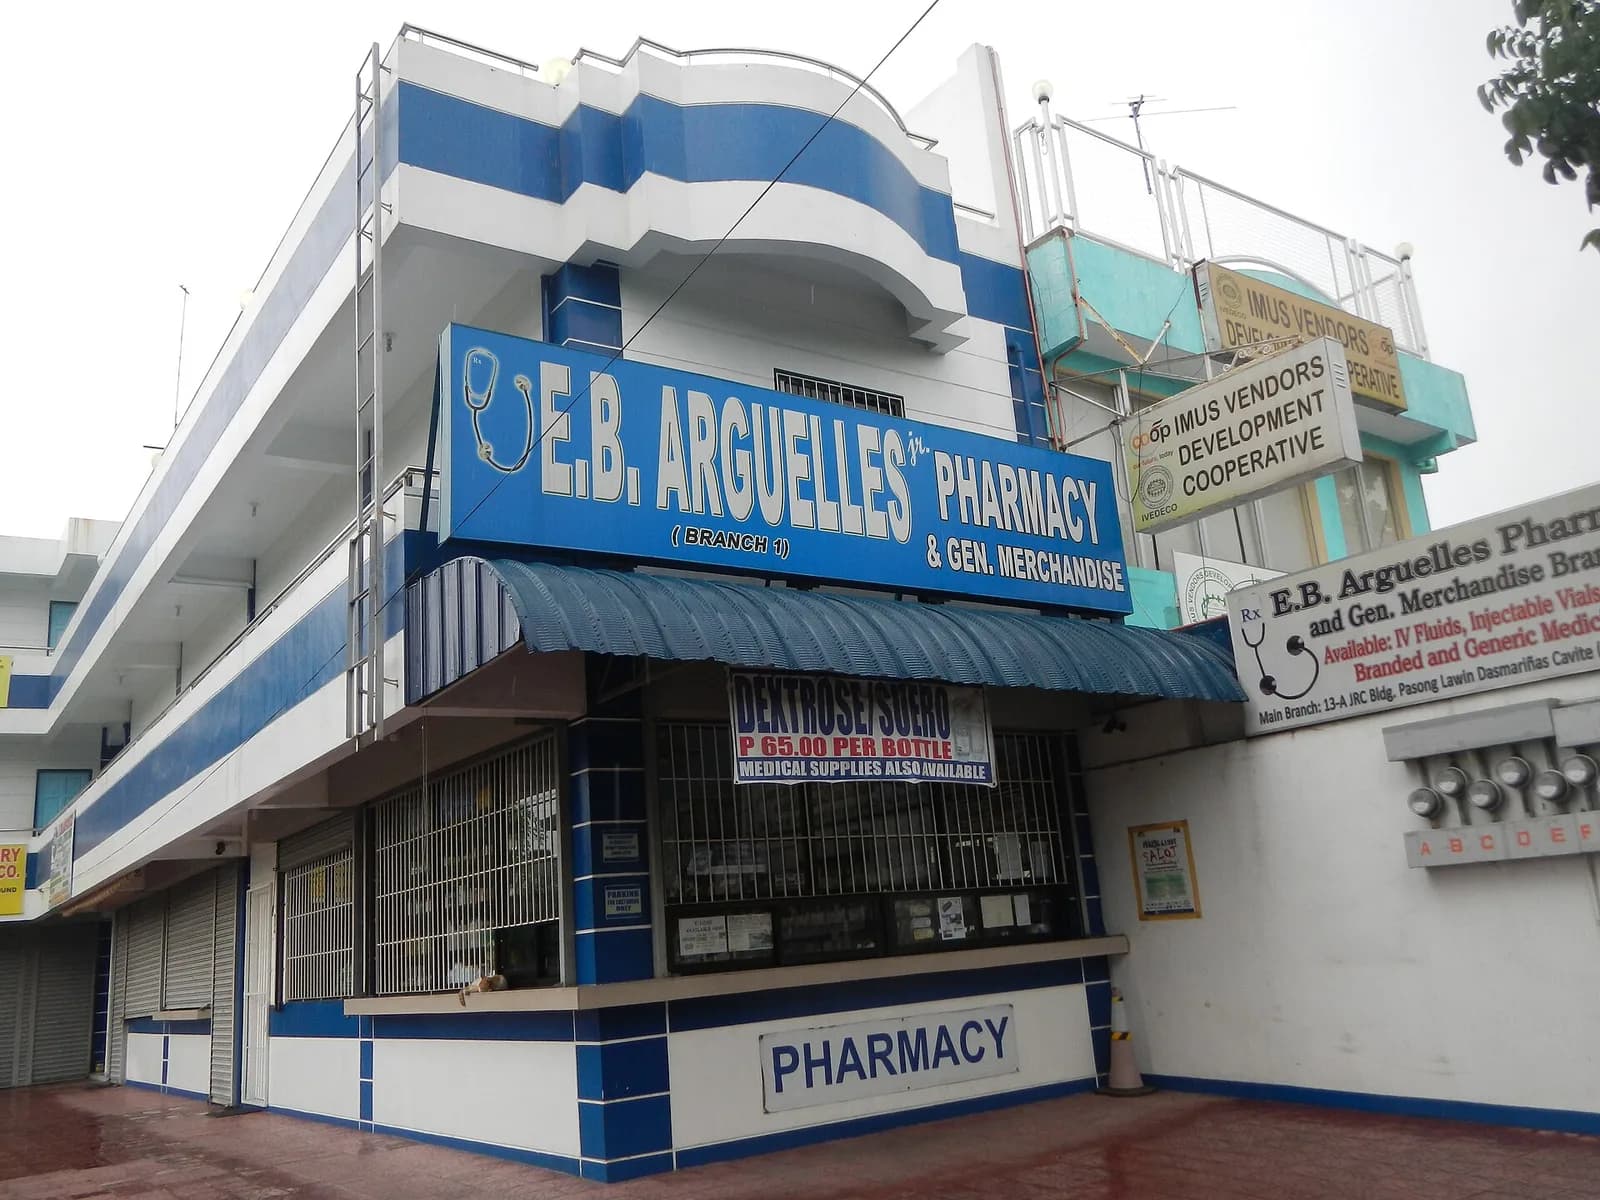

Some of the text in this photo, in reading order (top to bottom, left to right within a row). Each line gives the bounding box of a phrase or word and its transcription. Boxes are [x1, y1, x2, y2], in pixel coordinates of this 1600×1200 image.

[1247, 288, 1291, 329] IMUS
[1292, 304, 1369, 355] VENDORS
[1174, 355, 1324, 436] IMUS VENDORS
[1178, 389, 1325, 466] DEVELOPMENT
[540, 360, 641, 507] E.B.
[656, 385, 911, 544] ARGUELLES
[907, 431, 930, 465] jr.
[1183, 426, 1325, 496] COOPERATIVE
[933, 450, 1099, 545] PHARMACY
[1141, 503, 1178, 522] IVEDECO
[927, 534, 1125, 593] & GEN. MERCHANDISE
[1240, 608, 1262, 623] Rx
[1269, 581, 1332, 618] E.B.
[1337, 537, 1493, 601] Arguelles
[1309, 607, 1345, 638] and
[1348, 603, 1396, 628] Gen.
[1399, 562, 1545, 616] Merchandise
[1323, 633, 1393, 666] Available:
[1394, 625, 1411, 649] IV
[1414, 616, 1468, 645] Fluids,
[1468, 595, 1554, 634] Injectable
[1258, 708, 1283, 725] Main
[1285, 699, 1322, 720] Branch:
[1324, 695, 1348, 712] 13-A
[1369, 686, 1397, 703] Bldg.
[1399, 677, 1439, 697] Pasong
[1440, 669, 1475, 689] Lawin
[1477, 655, 1549, 681] Dasmariñas
[1552, 645, 1594, 666] Cavite
[1353, 650, 1424, 683] Branded
[1427, 641, 1461, 667] and
[1464, 627, 1538, 659] Generic
[739, 735, 953, 760] P 65.00 PER BOTTLE
[739, 760, 986, 780] MEDICAL SUPPLIES ALSO AVAILABLE
[1420, 841, 1431, 856] A
[1449, 838, 1464, 853] B
[1480, 834, 1495, 850] C
[1517, 830, 1531, 846] D
[1551, 827, 1566, 843] E
[772, 1016, 1009, 1093] PHARMACY
